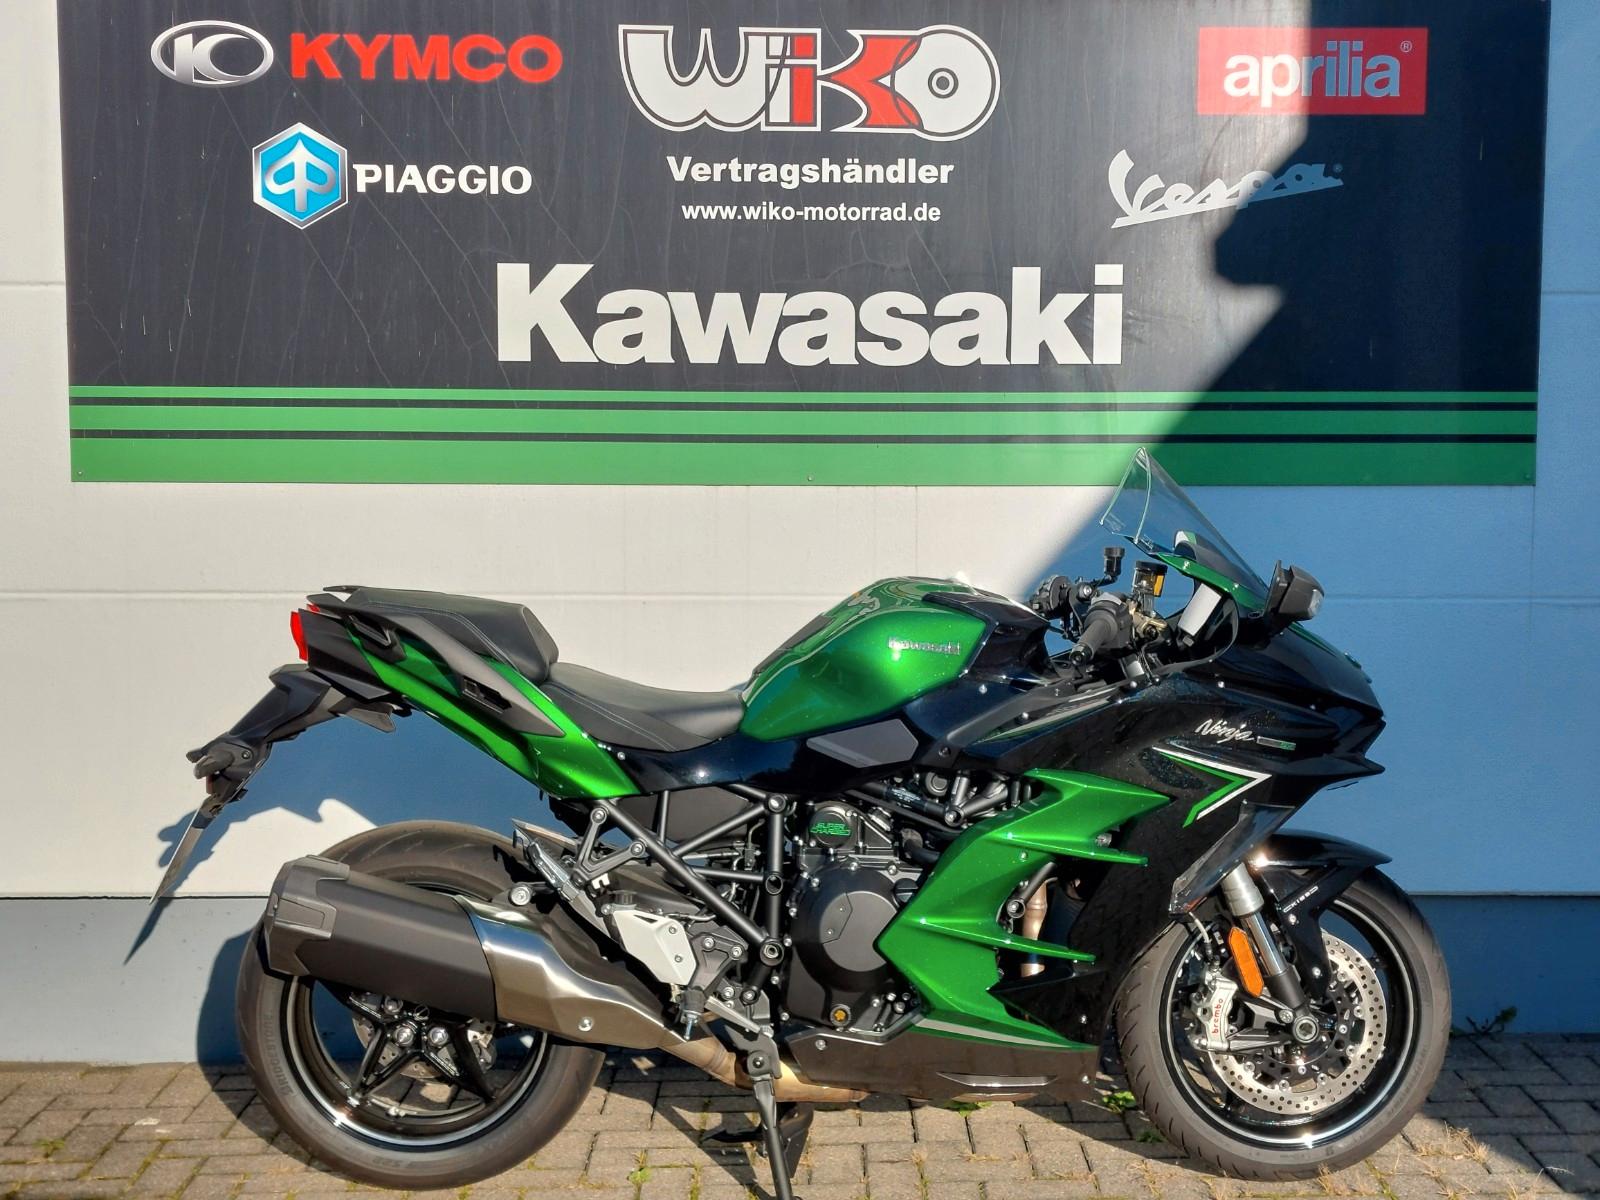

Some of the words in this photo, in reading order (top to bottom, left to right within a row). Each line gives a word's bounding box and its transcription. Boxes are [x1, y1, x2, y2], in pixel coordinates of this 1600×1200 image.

[290, 32, 563, 84] KYMCO
[1223, 40, 1401, 108] aprilia
[353, 164, 533, 195] PIAGGIO
[667, 156, 954, 189] Vertragshändler
[1108, 149, 1344, 228] Vespa
[682, 201, 941, 222] www.wiko-motorrad.de
[496, 262, 1124, 366] Kawasaki
[1195, 718, 1255, 744] Ninja
[1212, 998, 1224, 1034] brembo
